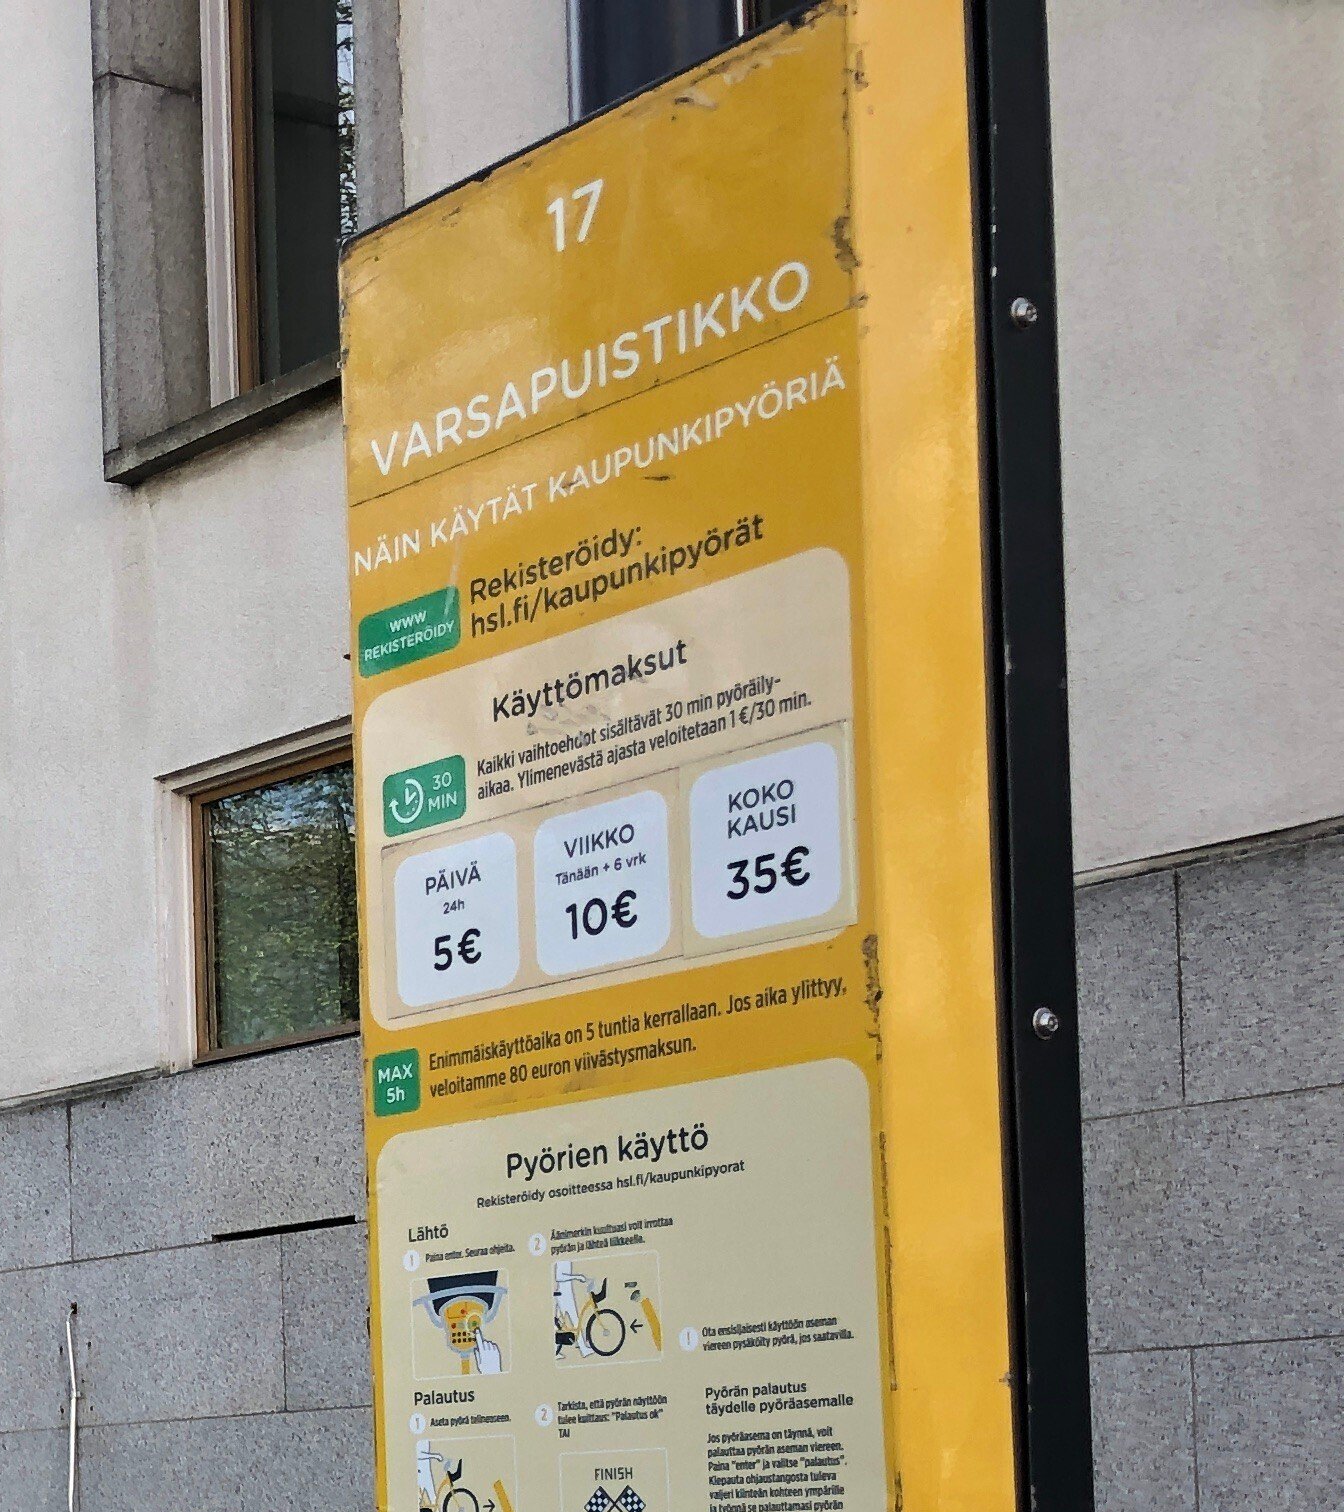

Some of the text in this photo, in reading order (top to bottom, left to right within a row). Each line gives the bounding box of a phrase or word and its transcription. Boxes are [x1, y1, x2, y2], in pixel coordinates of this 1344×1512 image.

[546, 179, 604, 251] 17
[369, 262, 810, 476] VARSAPUISTIKKO
[354, 355, 846, 576] NÄIN KÄYTÄT KAUPUNKIPYÖRIÄ
[470, 526, 642, 605] Rekisteröidy:
[471, 514, 764, 638] hsl.fi/kaupunkipyörät
[364, 620, 454, 661] REKISTERÖIDY
[492, 640, 688, 722] Käyttömaksut
[477, 675, 781, 777] Kaikki vaihtoehdot sisältävät 30 min pyöräily-
[477, 779, 515, 800] aikaa.
[517, 750, 603, 789] Ylimenevästä
[607, 740, 646, 766] ajasta
[649, 715, 726, 751] veloitetaan
[779, 692, 812, 714] min.
[432, 771, 452, 791] 30
[728, 779, 795, 813] KOKO
[428, 791, 457, 813] MIN
[727, 804, 796, 839] KAUSI
[564, 824, 634, 858] VIIKKO
[425, 861, 481, 895] PÄIVÄ
[555, 866, 599, 886] Tänään
[614, 858, 622, 871] 6
[626, 853, 647, 868] vrk
[727, 845, 810, 900] 35€
[443, 899, 465, 915] 24h
[565, 889, 638, 940] 10€
[433, 927, 482, 972] 5€
[429, 1030, 561, 1071] Enimmäiskäyttöaika
[564, 1029, 582, 1045] on
[586, 1023, 594, 1042] 5
[598, 1014, 640, 1038] tuntia
[643, 1001, 722, 1030] kerrallaan.
[726, 995, 751, 1014] Jos
[755, 987, 787, 1008] aika
[377, 1063, 413, 1084] MAX
[430, 1037, 697, 1098] veloitamme 80 euron viivästysmaksun.
[386, 1087, 406, 1104] 5h
[507, 1123, 708, 1181] Pyörien käyttö
[477, 1189, 545, 1208] Rekisteröidy
[548, 1179, 613, 1199] osoitteessa
[408, 1223, 449, 1243] Lähtö
[414, 1390, 475, 1406] Palautus
[705, 1382, 807, 1400] Pyörän palautus
[705, 1394, 854, 1416] täydelle pyöräasemalle
[558, 1429, 570, 1438] TAI
[594, 1467, 633, 1480] FINISH
